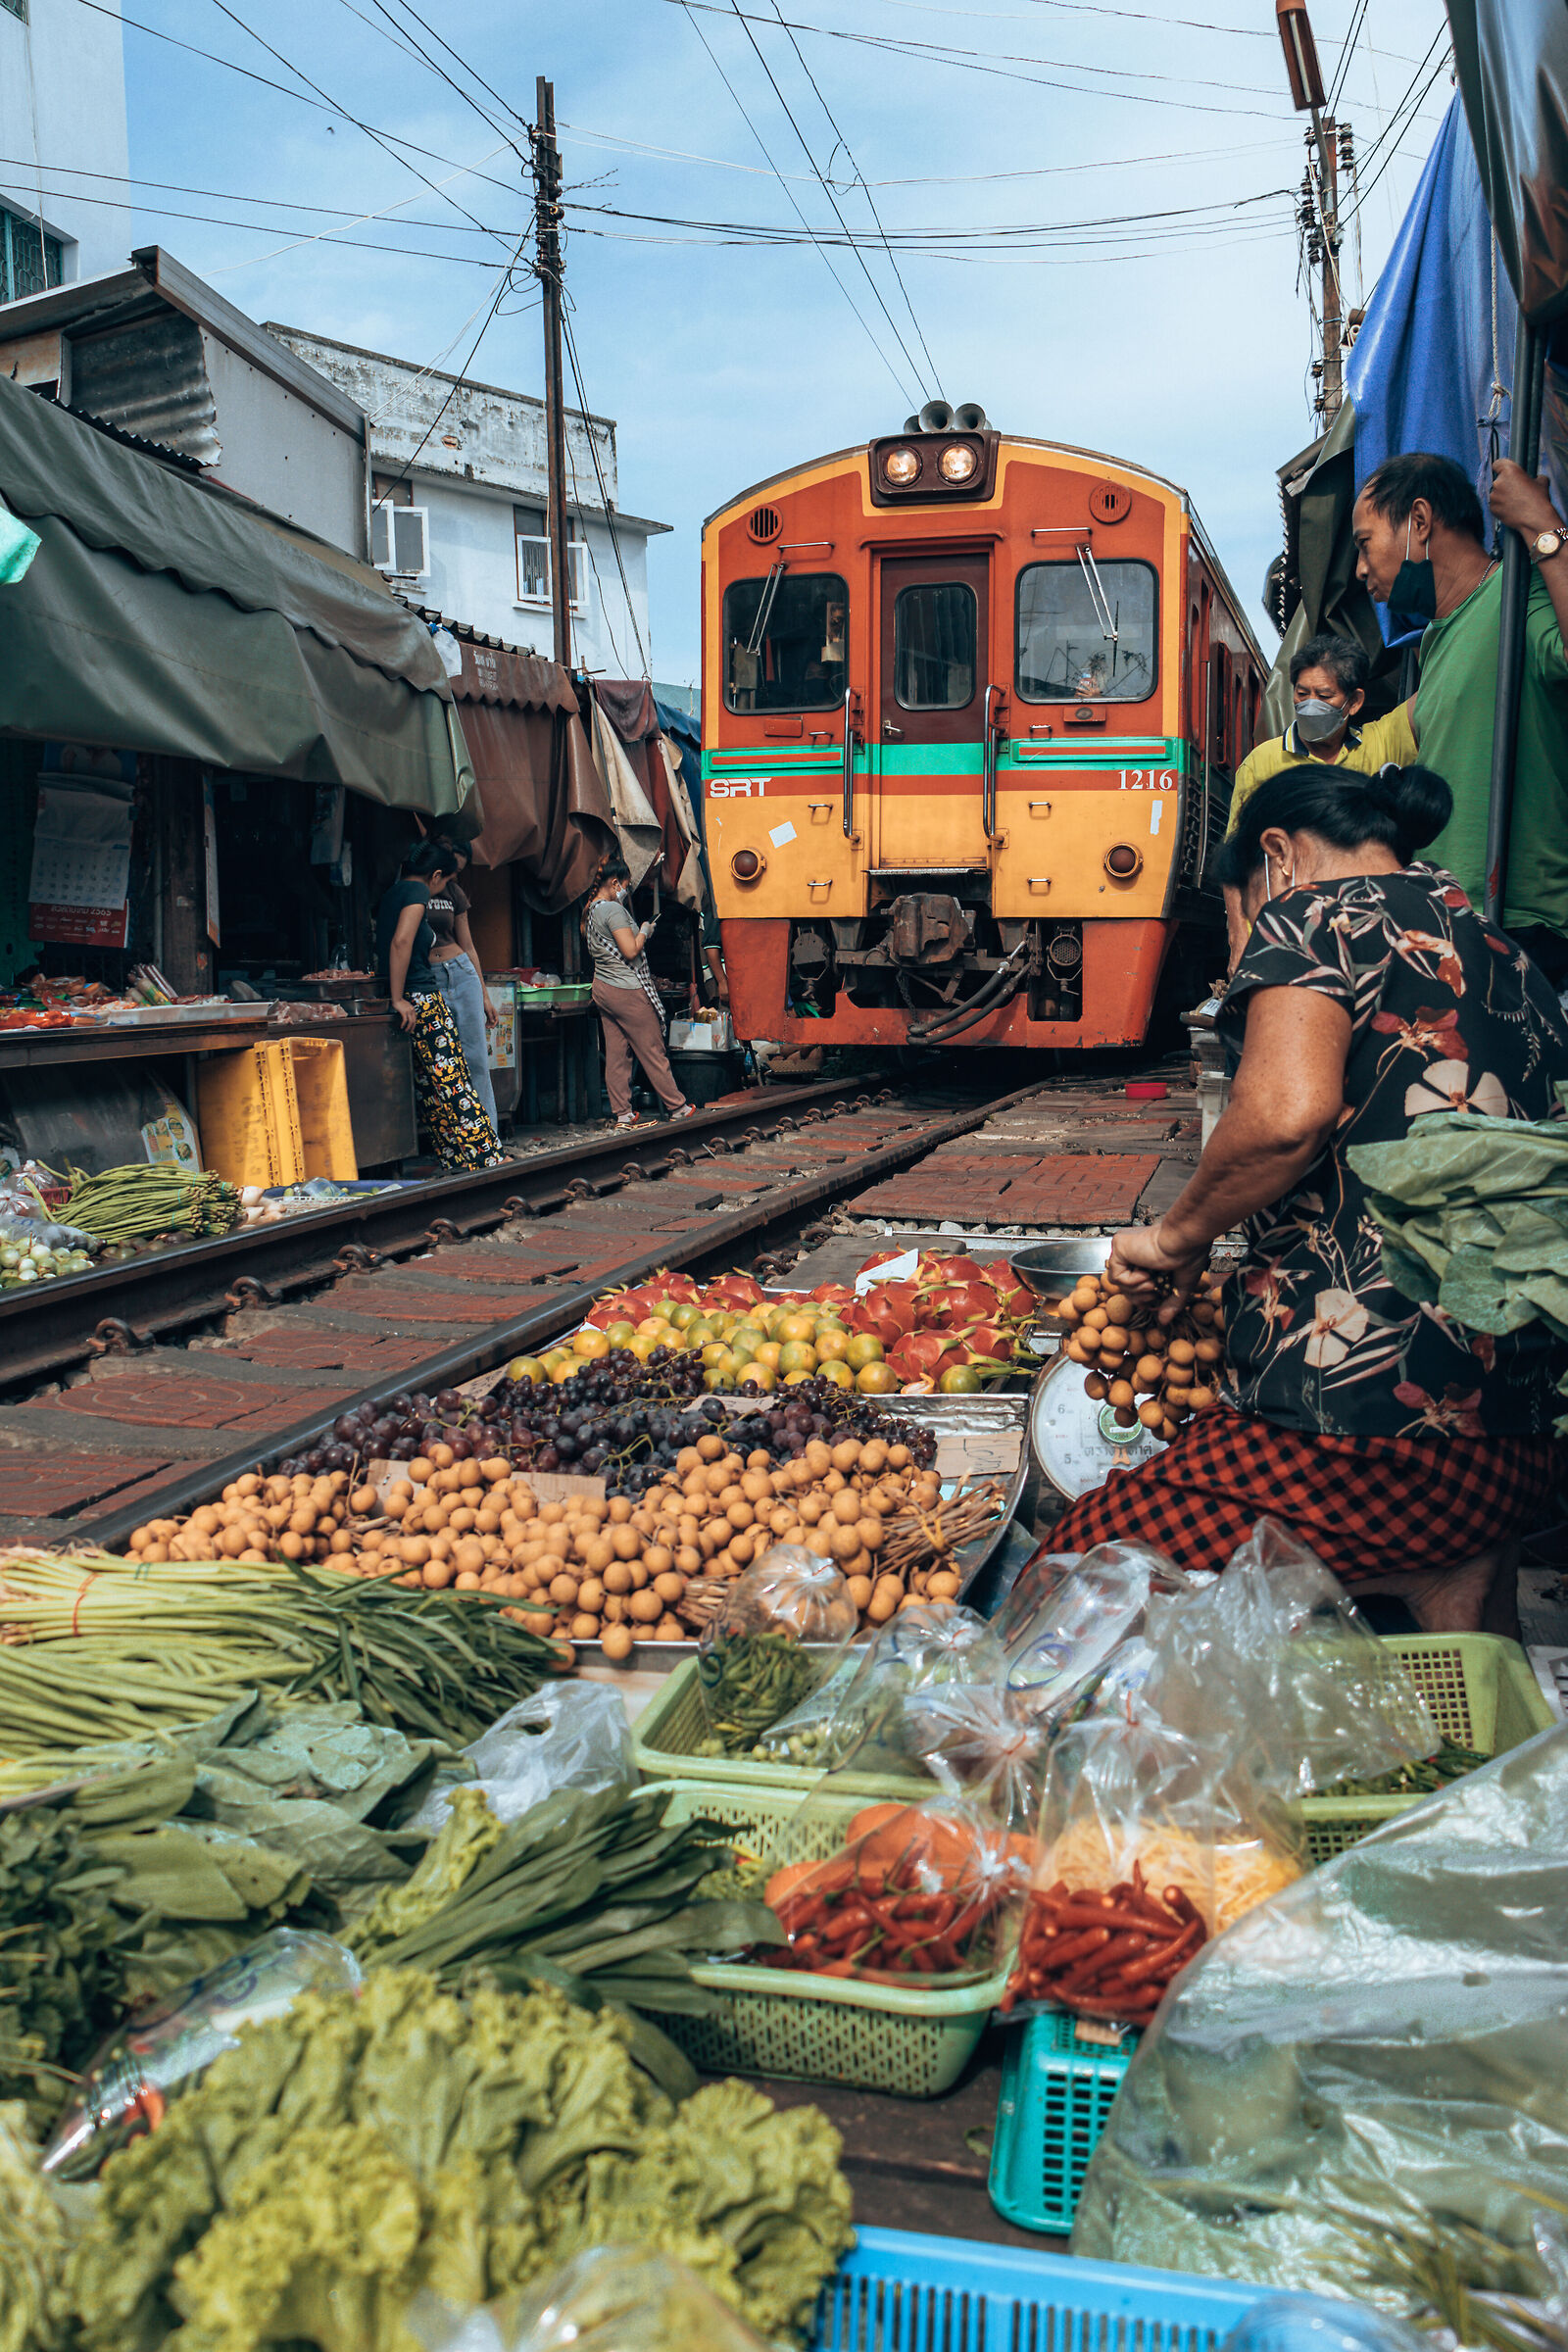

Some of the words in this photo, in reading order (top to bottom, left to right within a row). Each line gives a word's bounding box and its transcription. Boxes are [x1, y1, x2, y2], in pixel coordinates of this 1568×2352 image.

[710, 777, 772, 798] SRT
[1117, 769, 1173, 790] 1216
[1058, 1404, 1065, 1414] 6
[1064, 1453, 1072, 1464] 5
